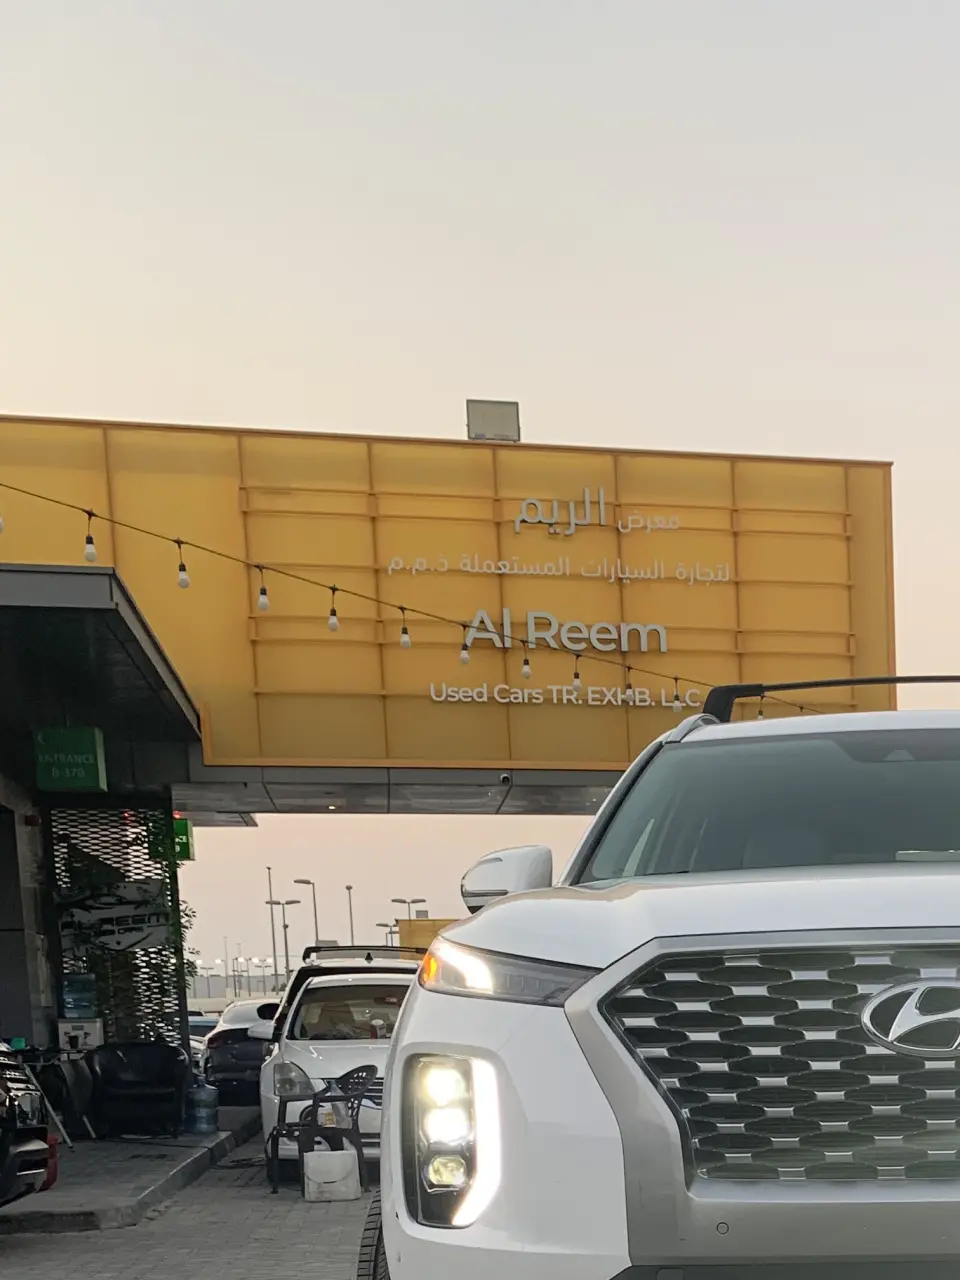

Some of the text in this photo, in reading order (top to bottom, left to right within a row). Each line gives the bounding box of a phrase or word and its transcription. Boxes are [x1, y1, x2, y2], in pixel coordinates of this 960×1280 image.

[514, 486, 681, 537] معرض الريم
[459, 553, 570, 576] المستعملة
[581, 557, 665, 584] السيارات
[675, 561, 731, 586] لتجارة
[465, 608, 668, 653] Al Reem
[429, 682, 489, 703] Used
[493, 684, 544, 705] Cars
[547, 685, 583, 705] TR.
